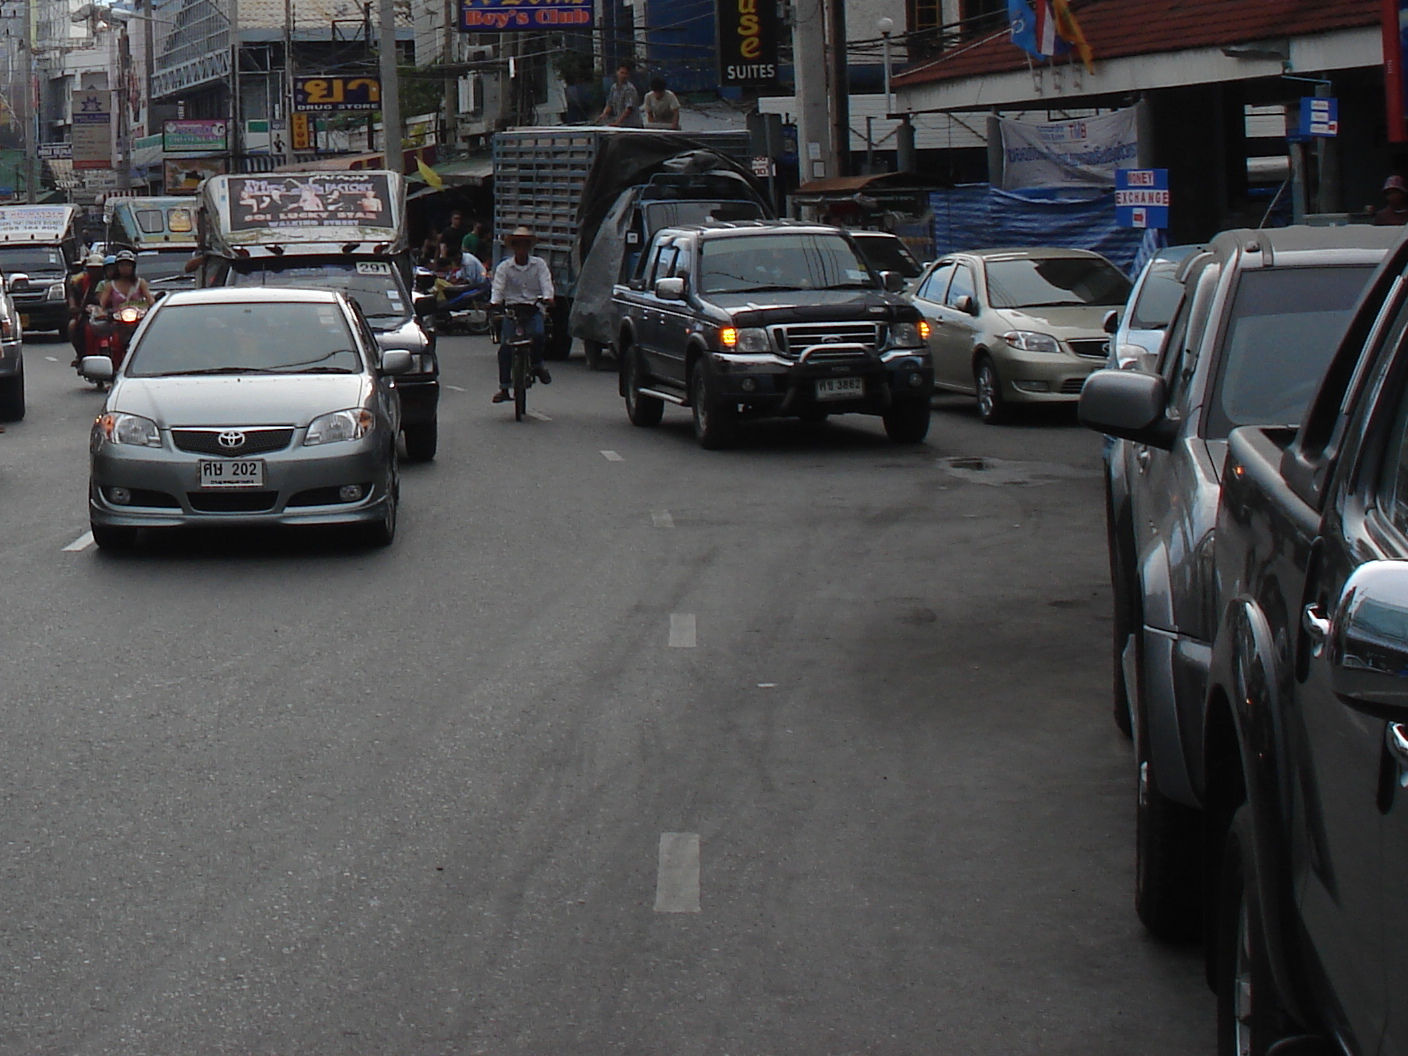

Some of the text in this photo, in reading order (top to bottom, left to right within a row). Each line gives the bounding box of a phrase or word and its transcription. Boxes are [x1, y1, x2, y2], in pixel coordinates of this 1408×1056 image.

[465, 8, 590, 28] Boy's Club
[727, 64, 775, 79] SUITES
[304, 78, 380, 103] ยา
[1115, 192, 1170, 204] EXCHANGE
[359, 263, 389, 274] 291
[232, 463, 257, 475] 202
